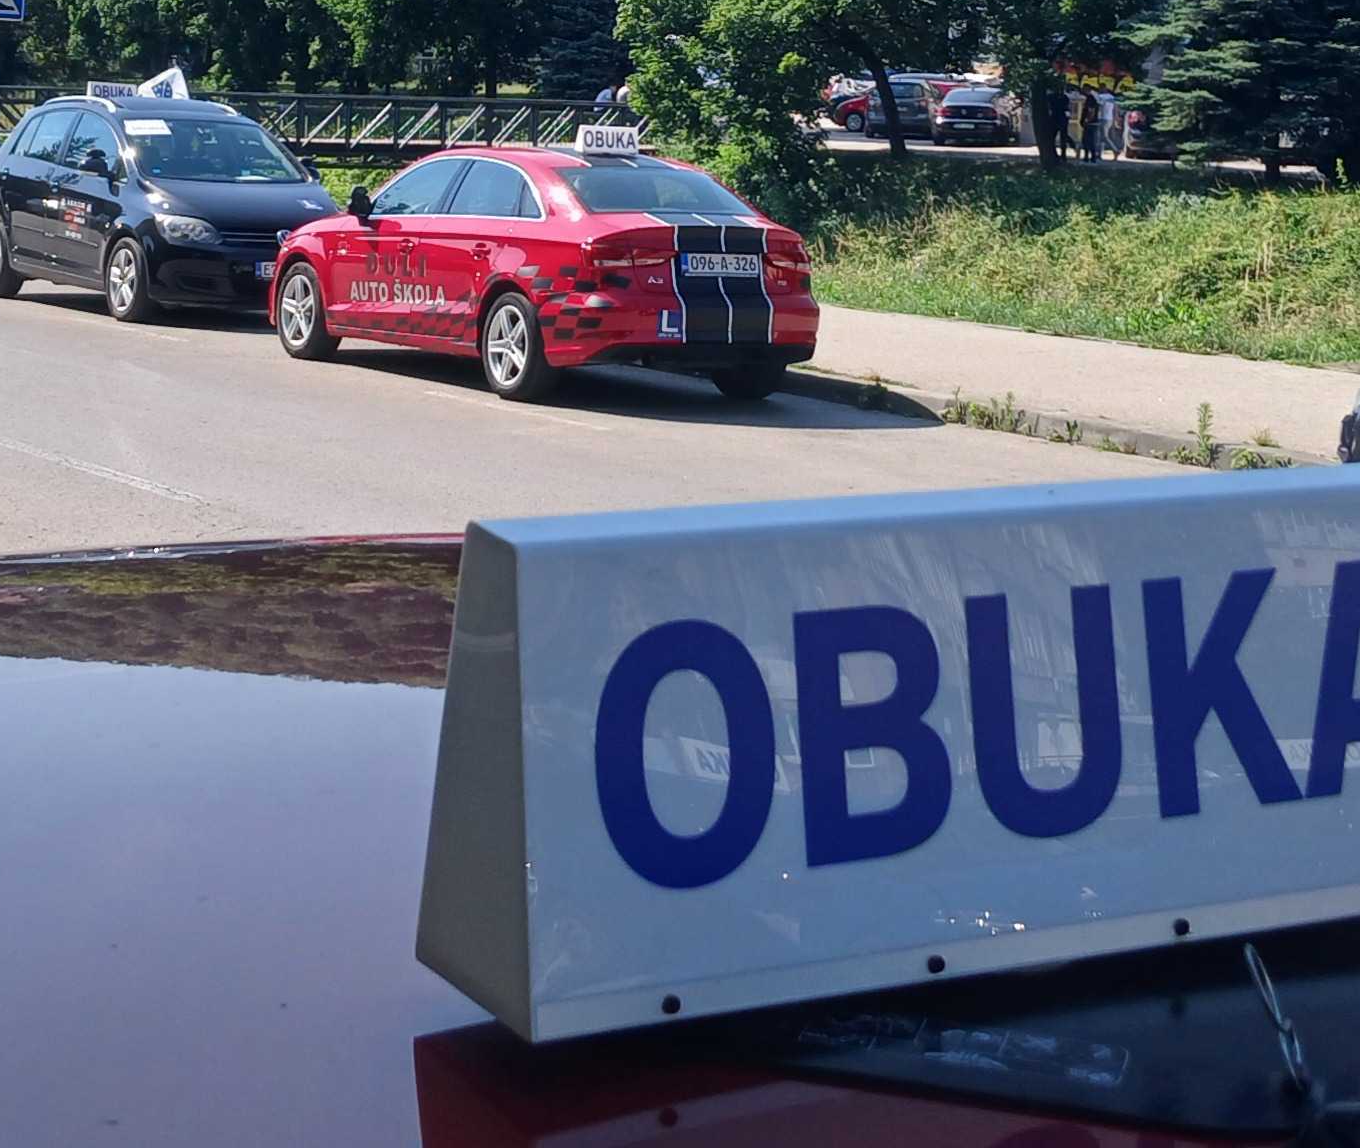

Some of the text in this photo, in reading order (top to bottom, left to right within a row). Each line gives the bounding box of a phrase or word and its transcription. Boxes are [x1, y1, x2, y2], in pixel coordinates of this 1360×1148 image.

[94, 85, 133, 97] OBUKA
[583, 130, 636, 149] OBUKA
[690, 254, 757, 272] 096-A-326
[350, 279, 445, 305] AUTO ŠKOLA
[661, 310, 679, 332] L
